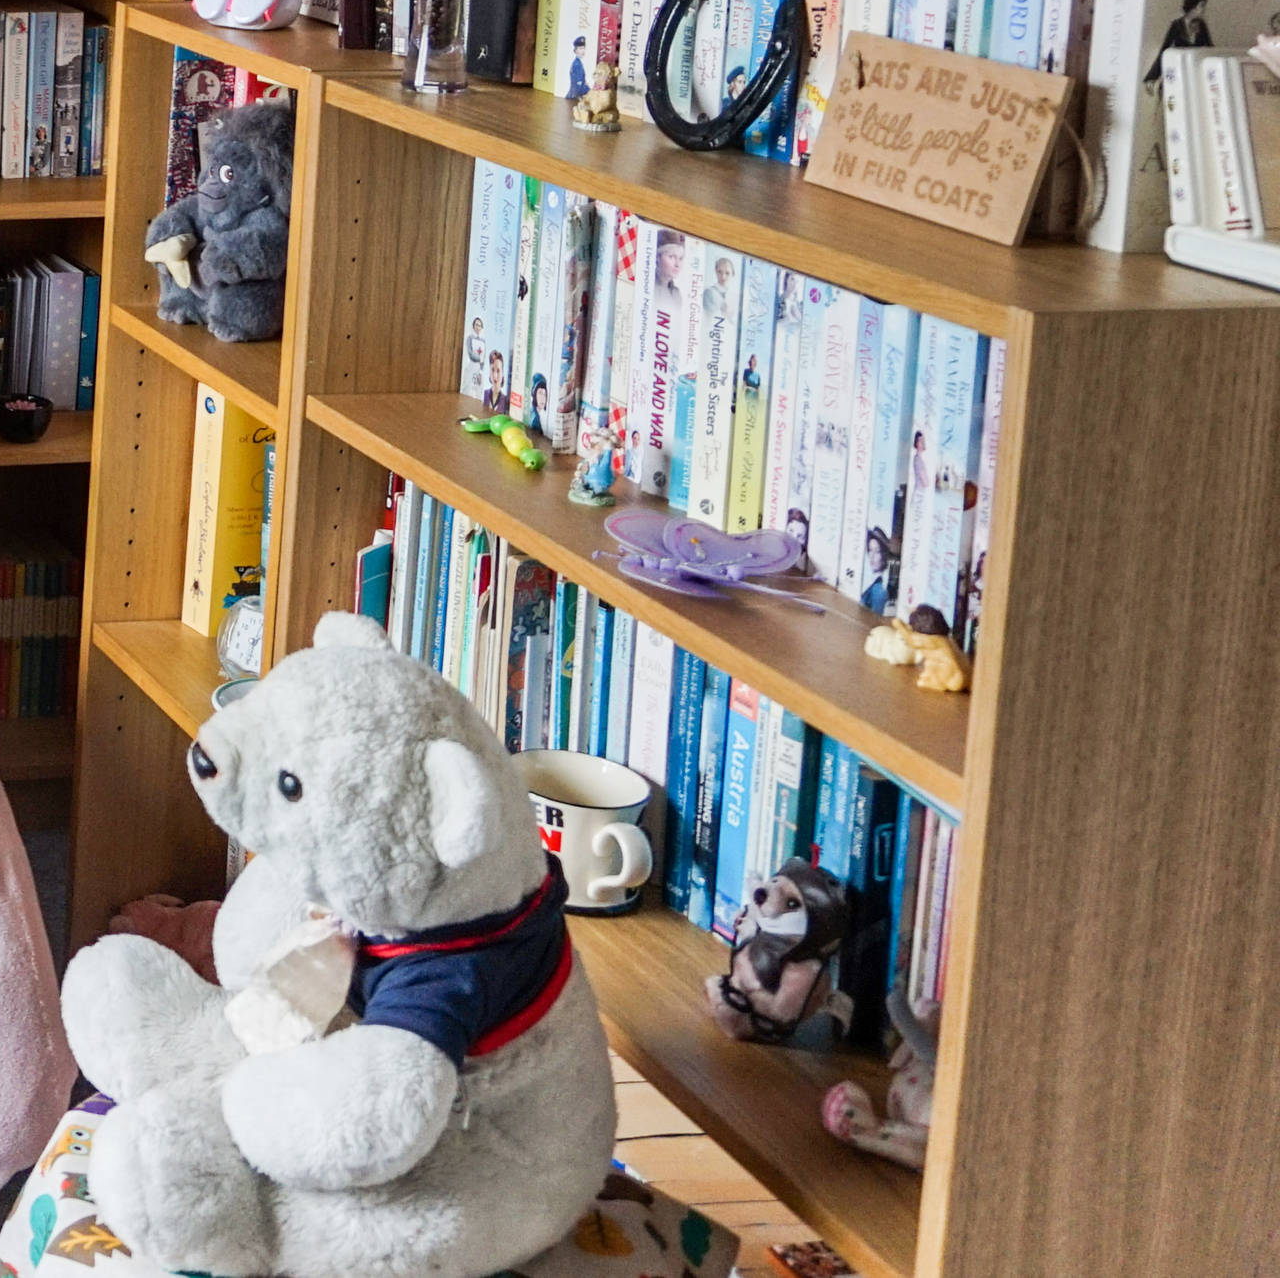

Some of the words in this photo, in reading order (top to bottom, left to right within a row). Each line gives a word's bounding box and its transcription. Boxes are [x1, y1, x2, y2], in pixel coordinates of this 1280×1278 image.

[627, 8, 644, 83] Daughter
[809, 3, 828, 59] Towers
[915, 65, 969, 103] ARE
[970, 81, 1036, 127] JUST
[860, 102, 913, 152] little
[909, 118, 991, 167] people
[832, 150, 858, 178] IN
[860, 159, 908, 195] FUR
[913, 175, 995, 219] COATS
[642, 246, 654, 296] Liverpool
[688, 272, 704, 301] Fairy
[638, 297, 650, 363] Nightingales
[656, 310, 671, 327] IN
[653, 330, 670, 375] LOVE
[706, 315, 726, 391] Nightingale
[823, 322, 843, 411] GROVES
[652, 375, 668, 412] AND
[704, 393, 721, 438] Sisters
[940, 334, 962, 451] HAMILTON
[957, 379, 971, 416] Ruth
[648, 412, 664, 451] WAR
[726, 729, 751, 829] Austria
